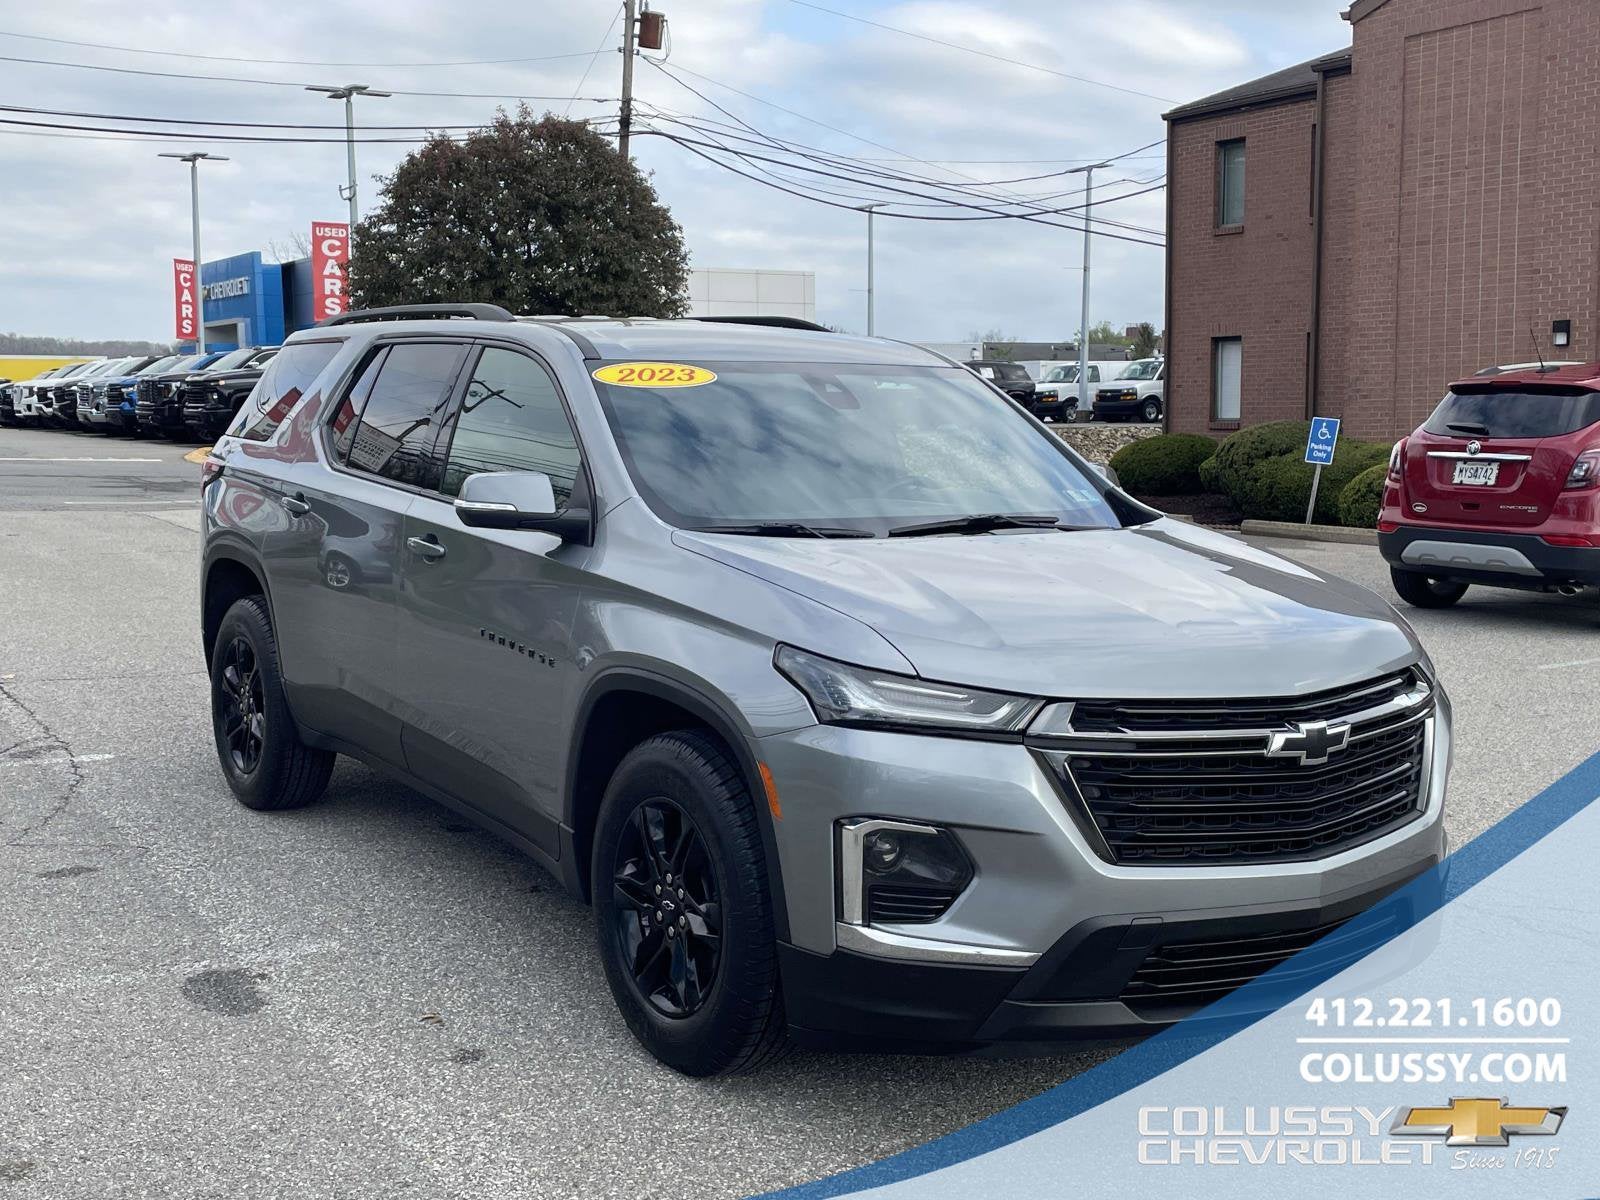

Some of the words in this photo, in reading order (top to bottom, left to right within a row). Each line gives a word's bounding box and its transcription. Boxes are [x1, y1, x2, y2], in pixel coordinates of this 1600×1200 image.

[316, 227, 346, 238] USED
[176, 262, 194, 272] USED
[321, 239, 342, 316] CARS
[210, 276, 250, 300] CHEVROLET
[179, 273, 193, 334] CARS
[617, 367, 696, 382] 2023
[1310, 442, 1332, 452] Parking
[1312, 450, 1328, 459] Only
[1458, 467, 1494, 481] MYS4742
